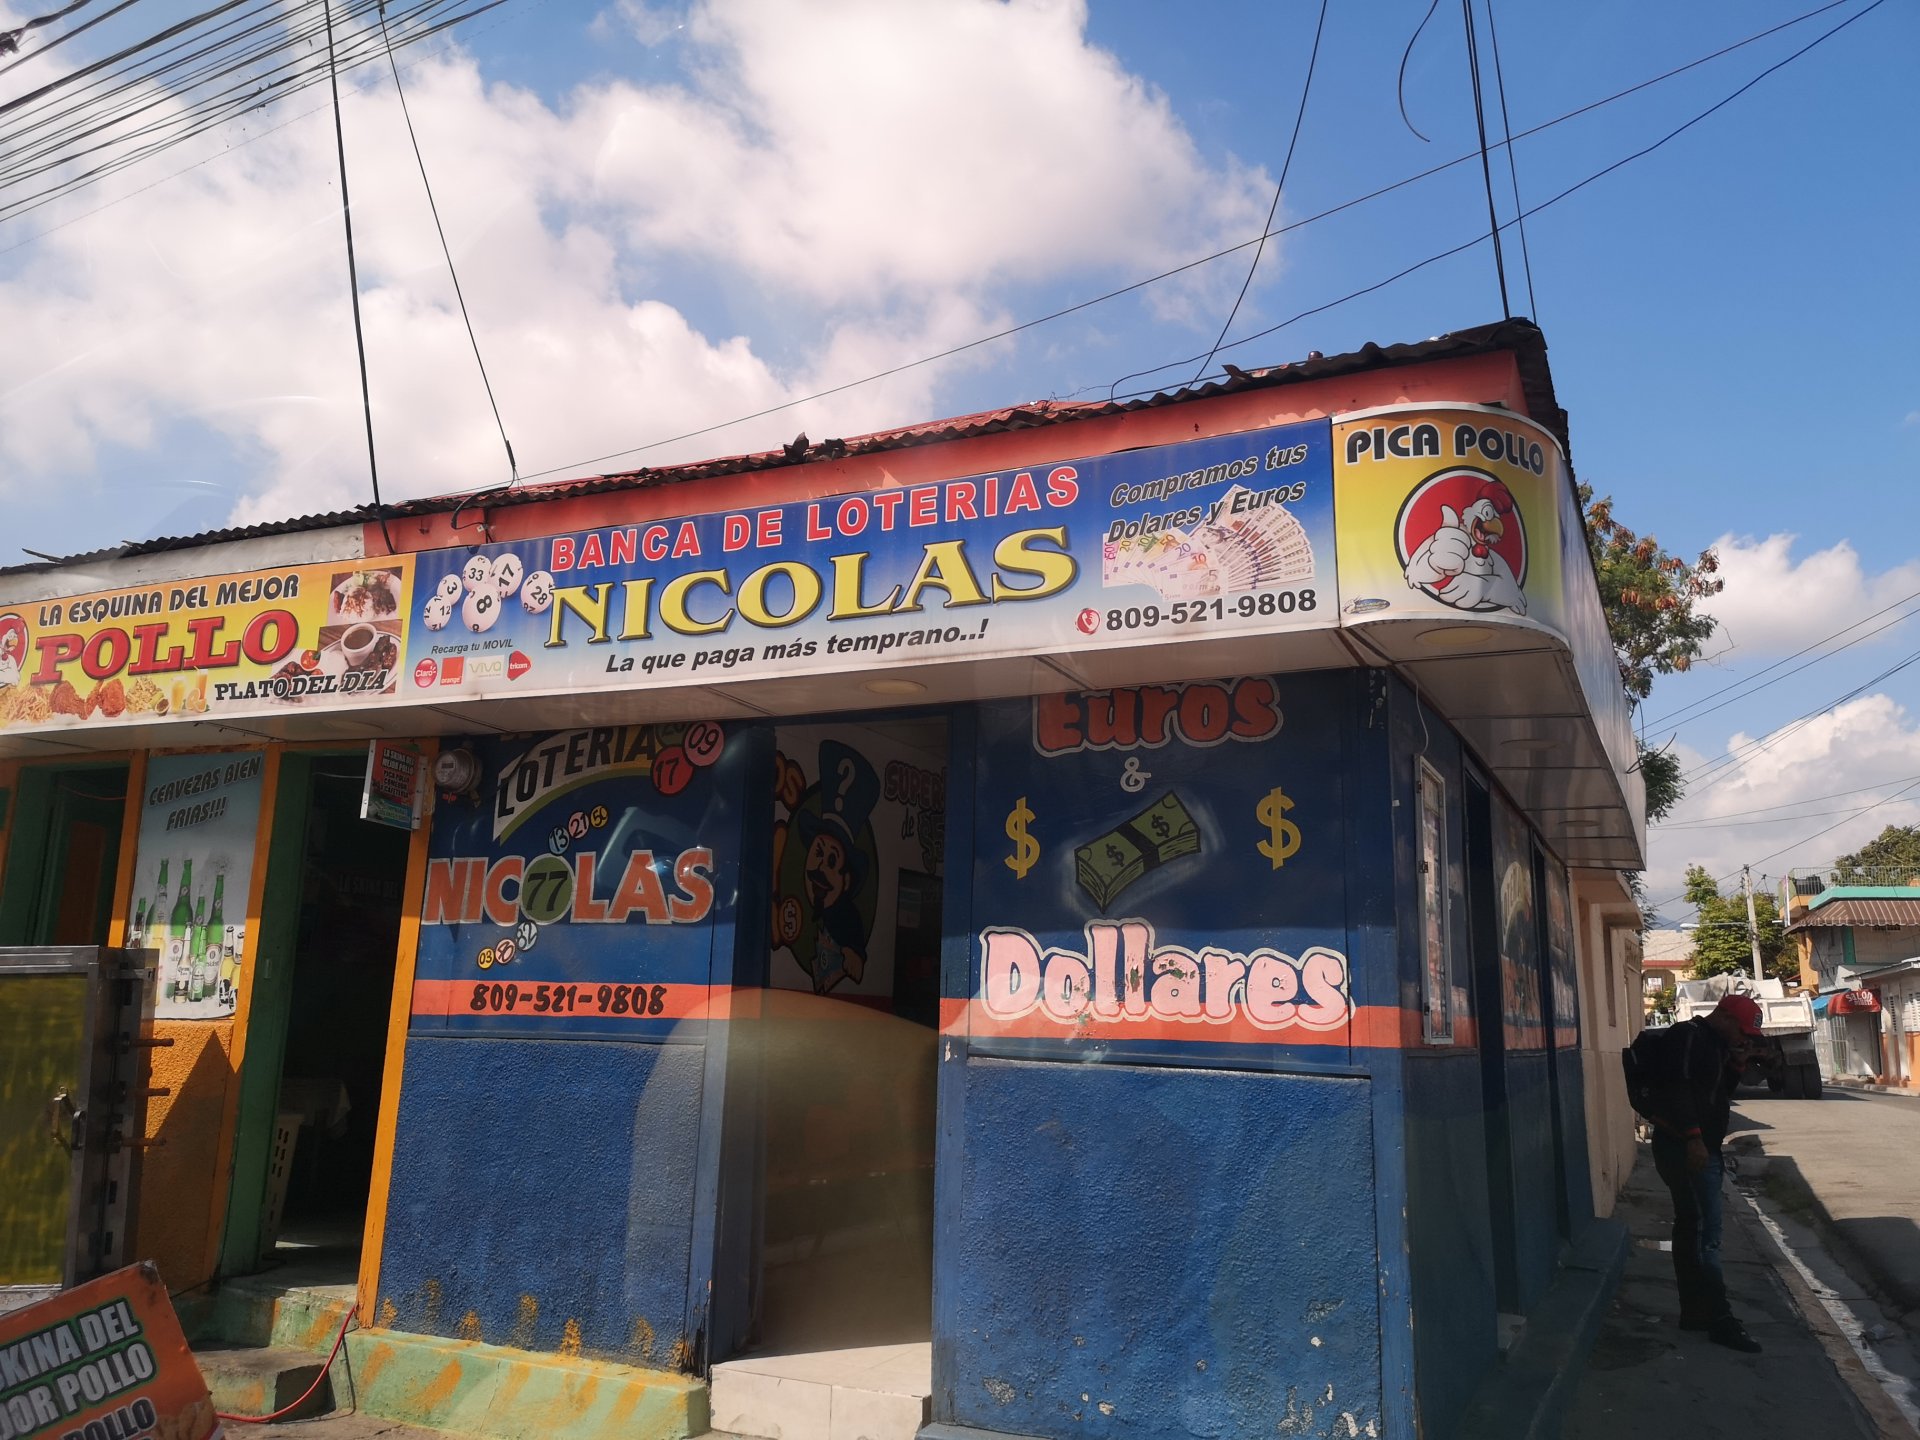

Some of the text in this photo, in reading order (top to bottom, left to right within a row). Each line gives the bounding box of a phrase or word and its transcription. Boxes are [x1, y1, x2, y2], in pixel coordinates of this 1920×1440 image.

[1346, 423, 1545, 476] PICA POLLO
[1110, 442, 1307, 508] Compramos tus
[550, 466, 1080, 572] BANCA DE LOTERIAS
[1107, 482, 1306, 545] Dolares y Euros
[469, 568, 484, 582] 33
[499, 563, 514, 587] 17
[1192, 553, 1206, 565] 10
[39, 573, 300, 627] LA ESQUINA DEL MEJOR
[447, 582, 458, 595] 3
[477, 595, 492, 613] 8
[531, 586, 548, 605] 28
[543, 527, 1077, 650] NICOLAS
[440, 606, 451, 616] 12
[1105, 589, 1317, 631] 809-521-9808
[30, 609, 300, 686] POLLO
[431, 639, 514, 655] Recarga tu MOVIL
[605, 653, 636, 674] La
[641, 652, 685, 672] que
[691, 645, 764, 671] paga
[770, 636, 819, 660] más
[215, 669, 388, 701] PLATO DEL DIA
[416, 668, 433, 678] Claro
[1036, 677, 1282, 754] Euros
[688, 723, 720, 756] 09
[150, 756, 262, 806] CERVEZAS BIEN
[653, 757, 679, 790] 17
[1121, 757, 1151, 793] &
[166, 797, 227, 831] FRIAS!!!
[981, 918, 1356, 1030] Dollares
[470, 983, 667, 1015] 809-521-9808
[80, 1301, 139, 1351] DEL
[57, 1343, 153, 1412] POLLO
